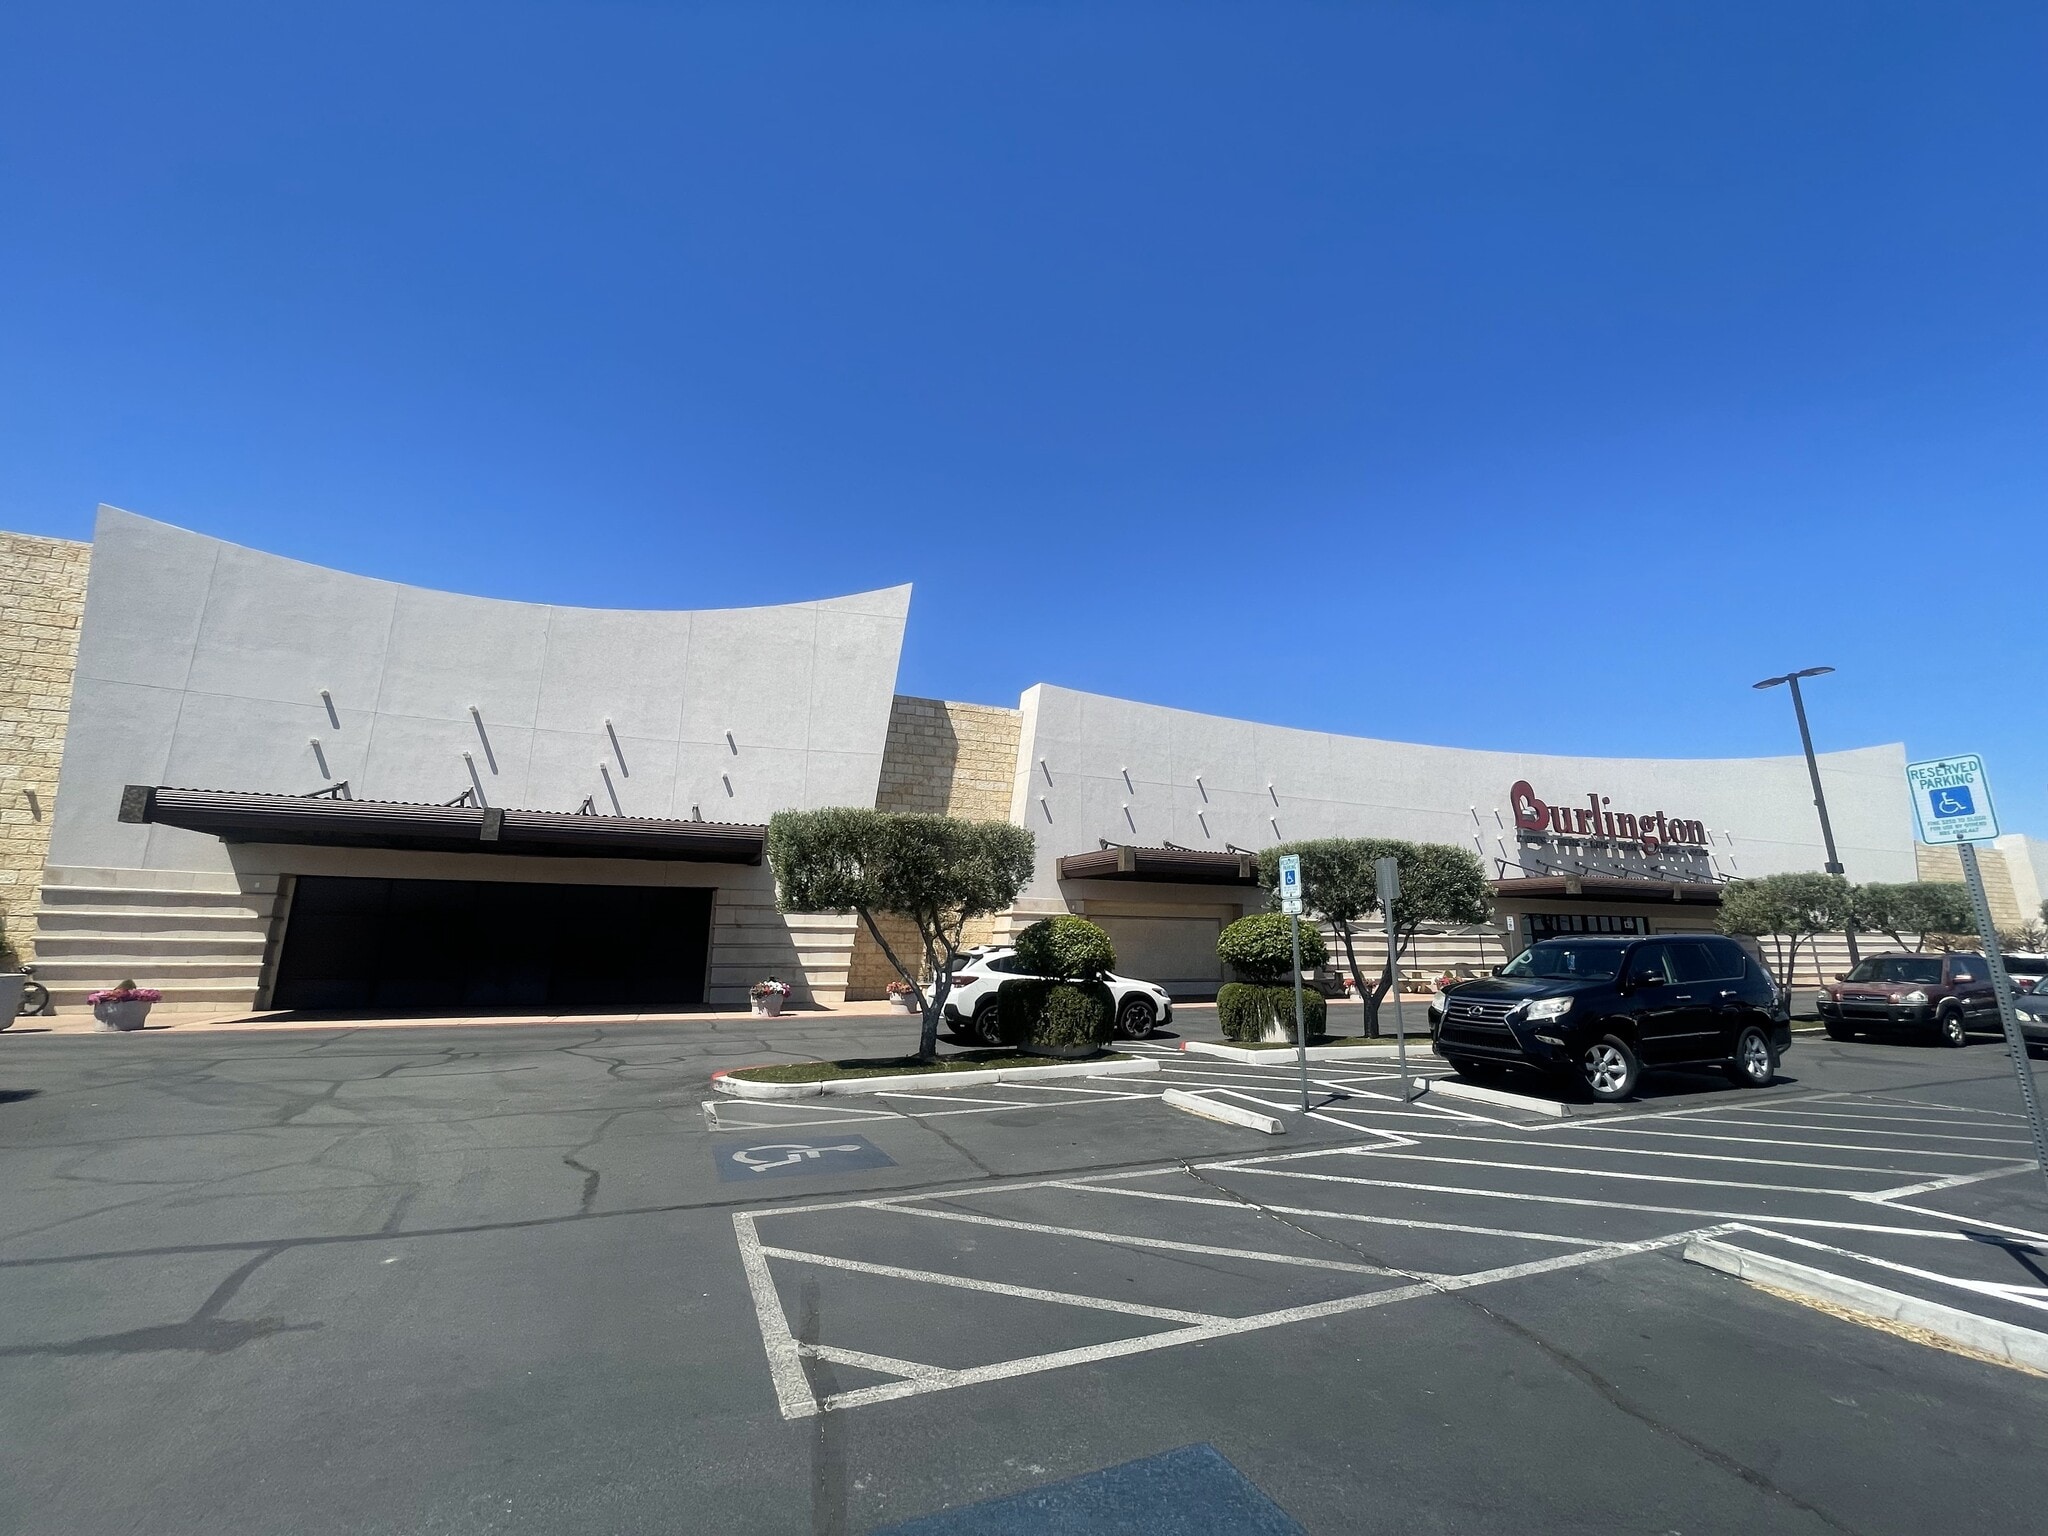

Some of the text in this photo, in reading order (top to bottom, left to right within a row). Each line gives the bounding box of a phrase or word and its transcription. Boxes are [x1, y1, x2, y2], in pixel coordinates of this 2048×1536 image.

[1910, 761, 1978, 780] RESERVED
[1920, 773, 1974, 790] PARKING
[1511, 780, 1709, 856] Burlington
